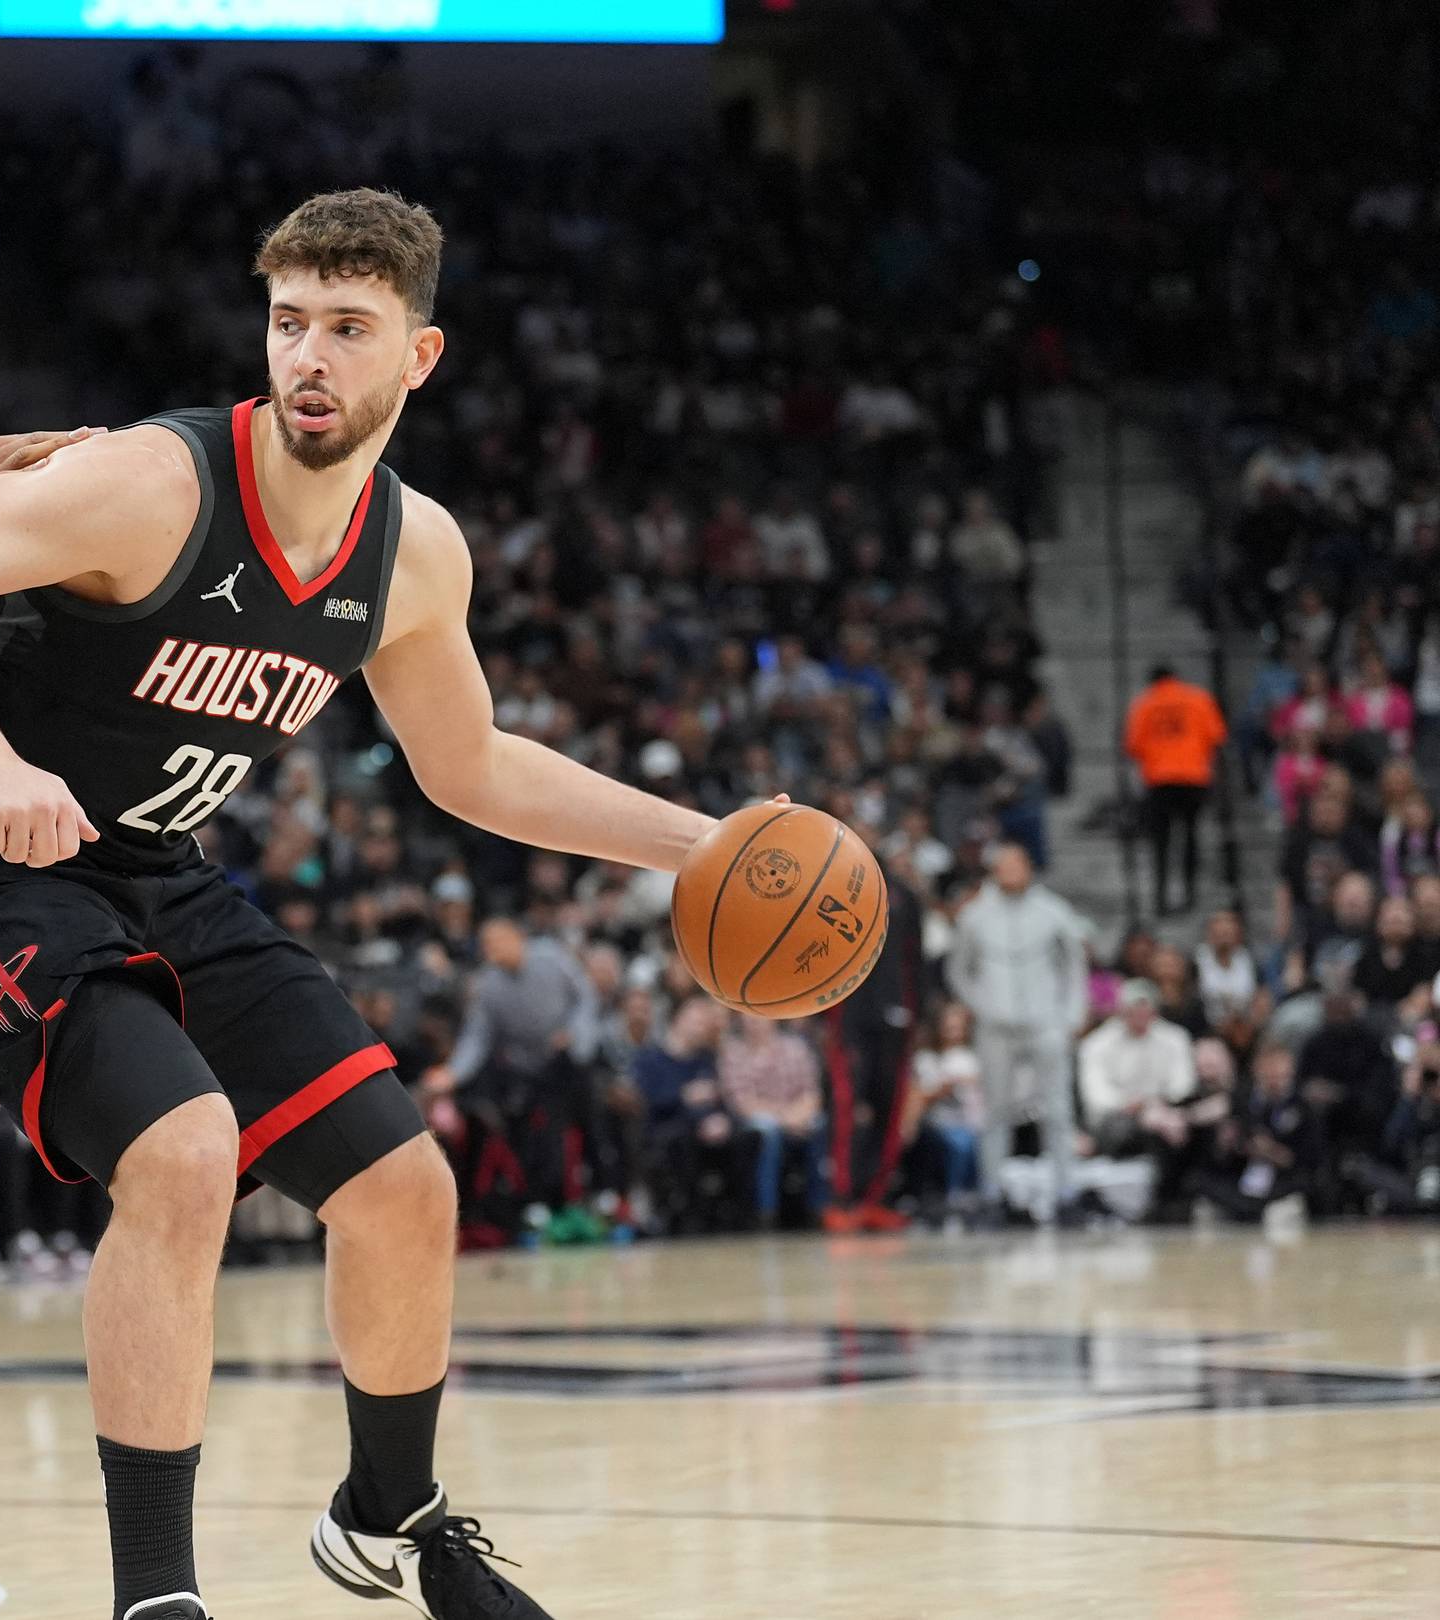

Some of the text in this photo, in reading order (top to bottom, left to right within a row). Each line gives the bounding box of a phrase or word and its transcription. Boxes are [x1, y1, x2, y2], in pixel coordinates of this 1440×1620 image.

[323, 606, 368, 622] HERMANN
[324, 597, 368, 613] MEMORIAL
[131, 638, 340, 736] HOUSTON
[116, 744, 252, 835] 28
